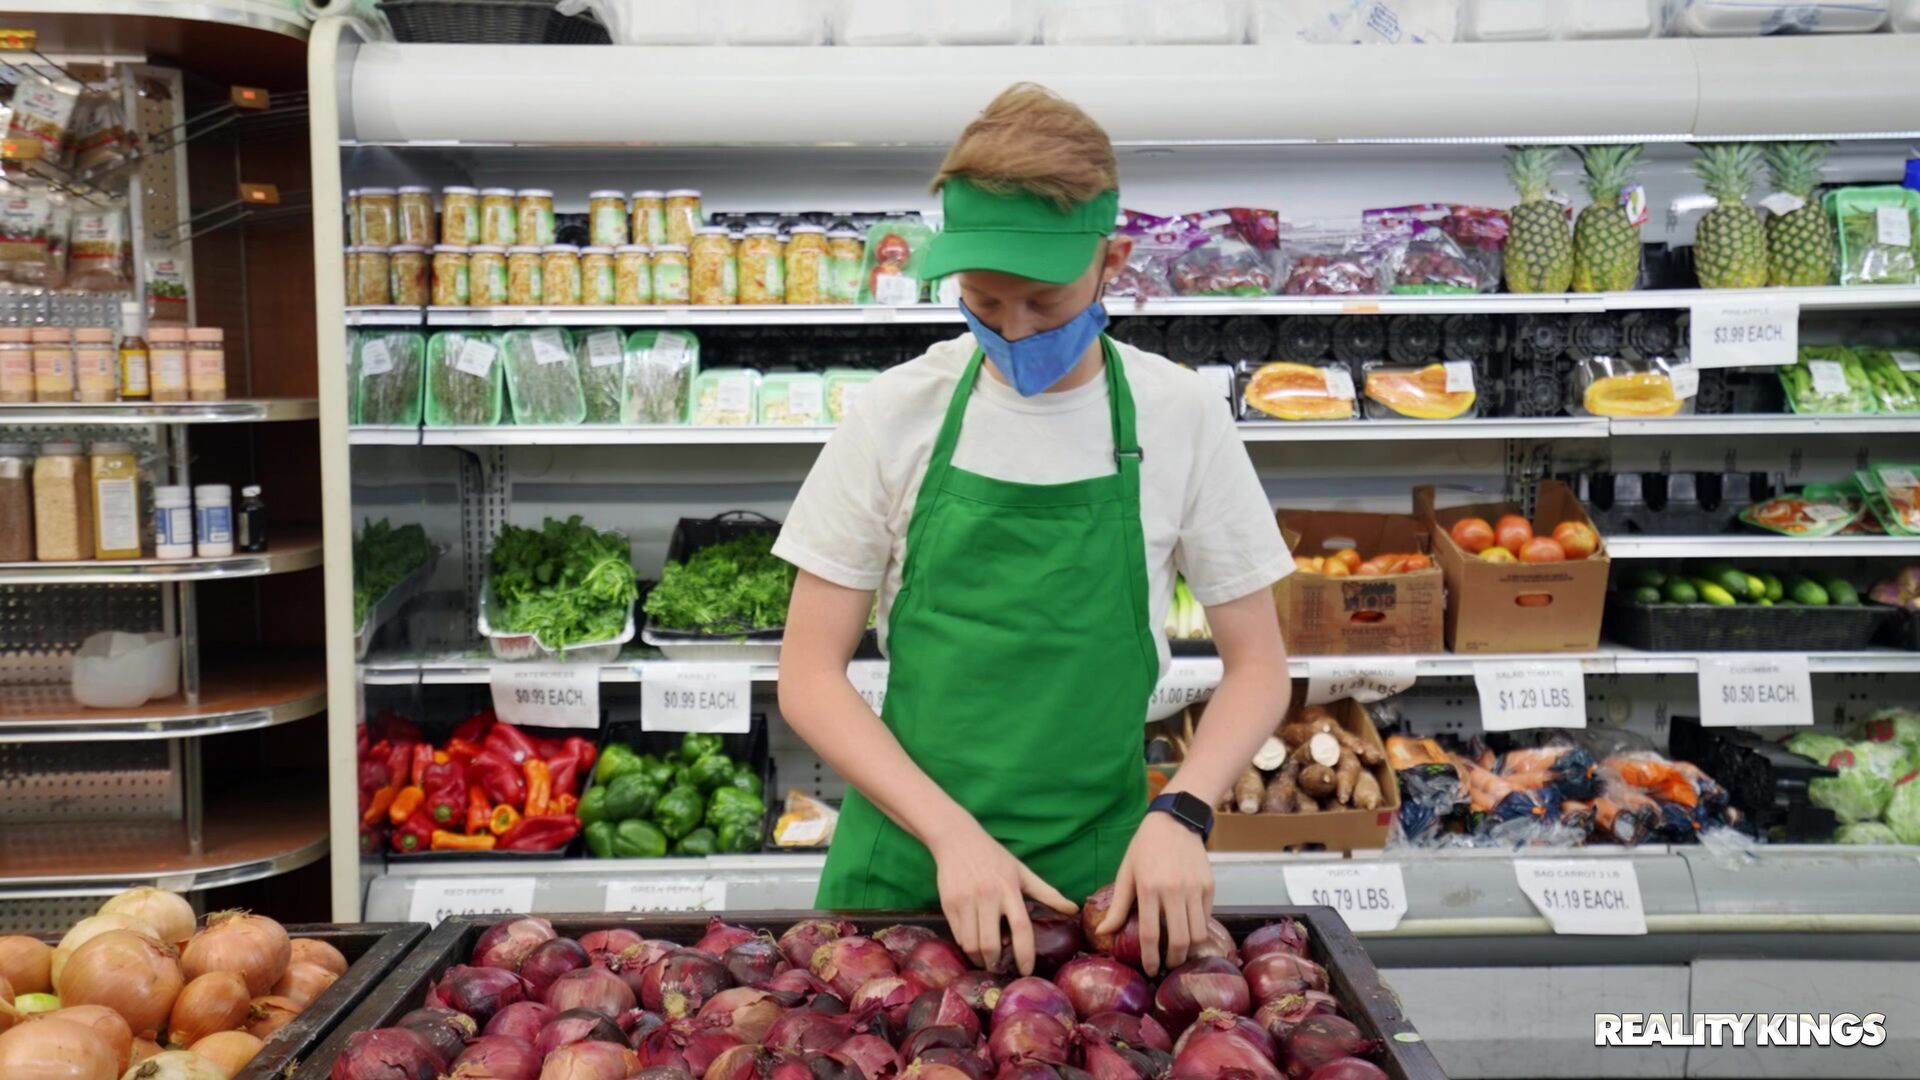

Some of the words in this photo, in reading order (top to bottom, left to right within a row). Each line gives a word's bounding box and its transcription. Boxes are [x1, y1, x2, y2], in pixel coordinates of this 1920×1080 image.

[1714, 326, 1745, 344] $3.99
[515, 688, 546, 705] $0.99
[549, 689, 586, 707] EACH.
[663, 691, 695, 709] $0.99
[699, 691, 739, 710] EACH.
[1499, 688, 1537, 711] $1.29
[1541, 687, 1575, 709] LBS.
[1722, 684, 1755, 704] $0.50
[1758, 684, 1799, 703] EACH.
[1533, 870, 1555, 878] BAG
[1557, 870, 1596, 879] CARROT
[1357, 887, 1395, 910] LBS.
[1544, 888, 1580, 910] $1.19
[1584, 888, 1630, 910] EACH.
